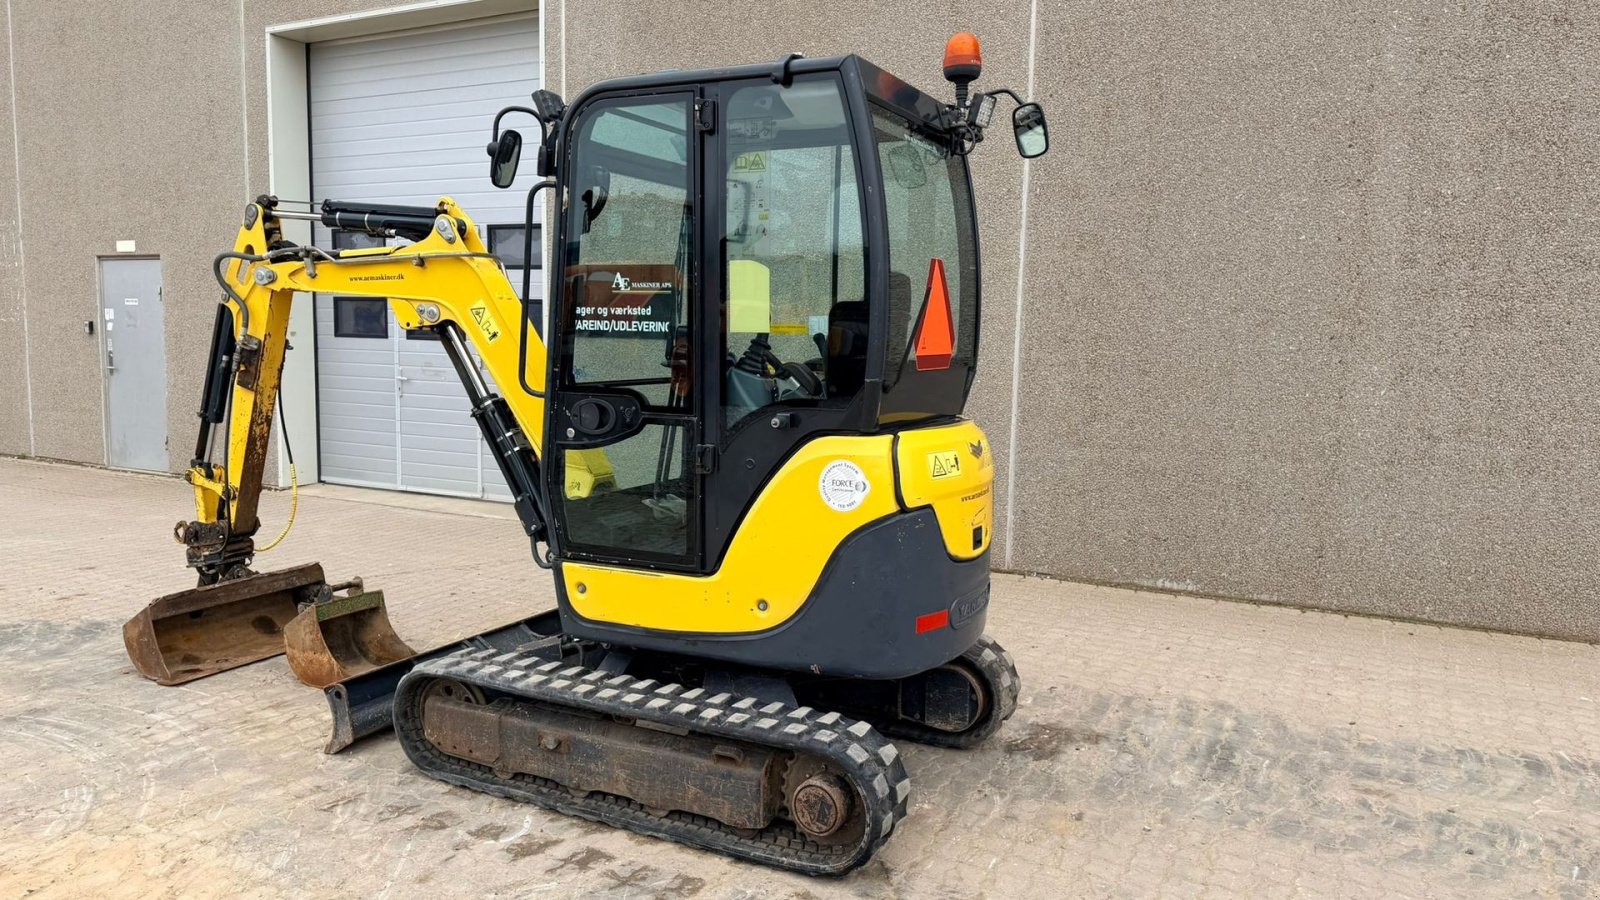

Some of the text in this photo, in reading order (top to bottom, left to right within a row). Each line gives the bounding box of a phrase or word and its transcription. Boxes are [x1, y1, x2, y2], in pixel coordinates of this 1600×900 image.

[575, 305, 651, 317] ager og værksted
[831, 479, 853, 488] FORCE
